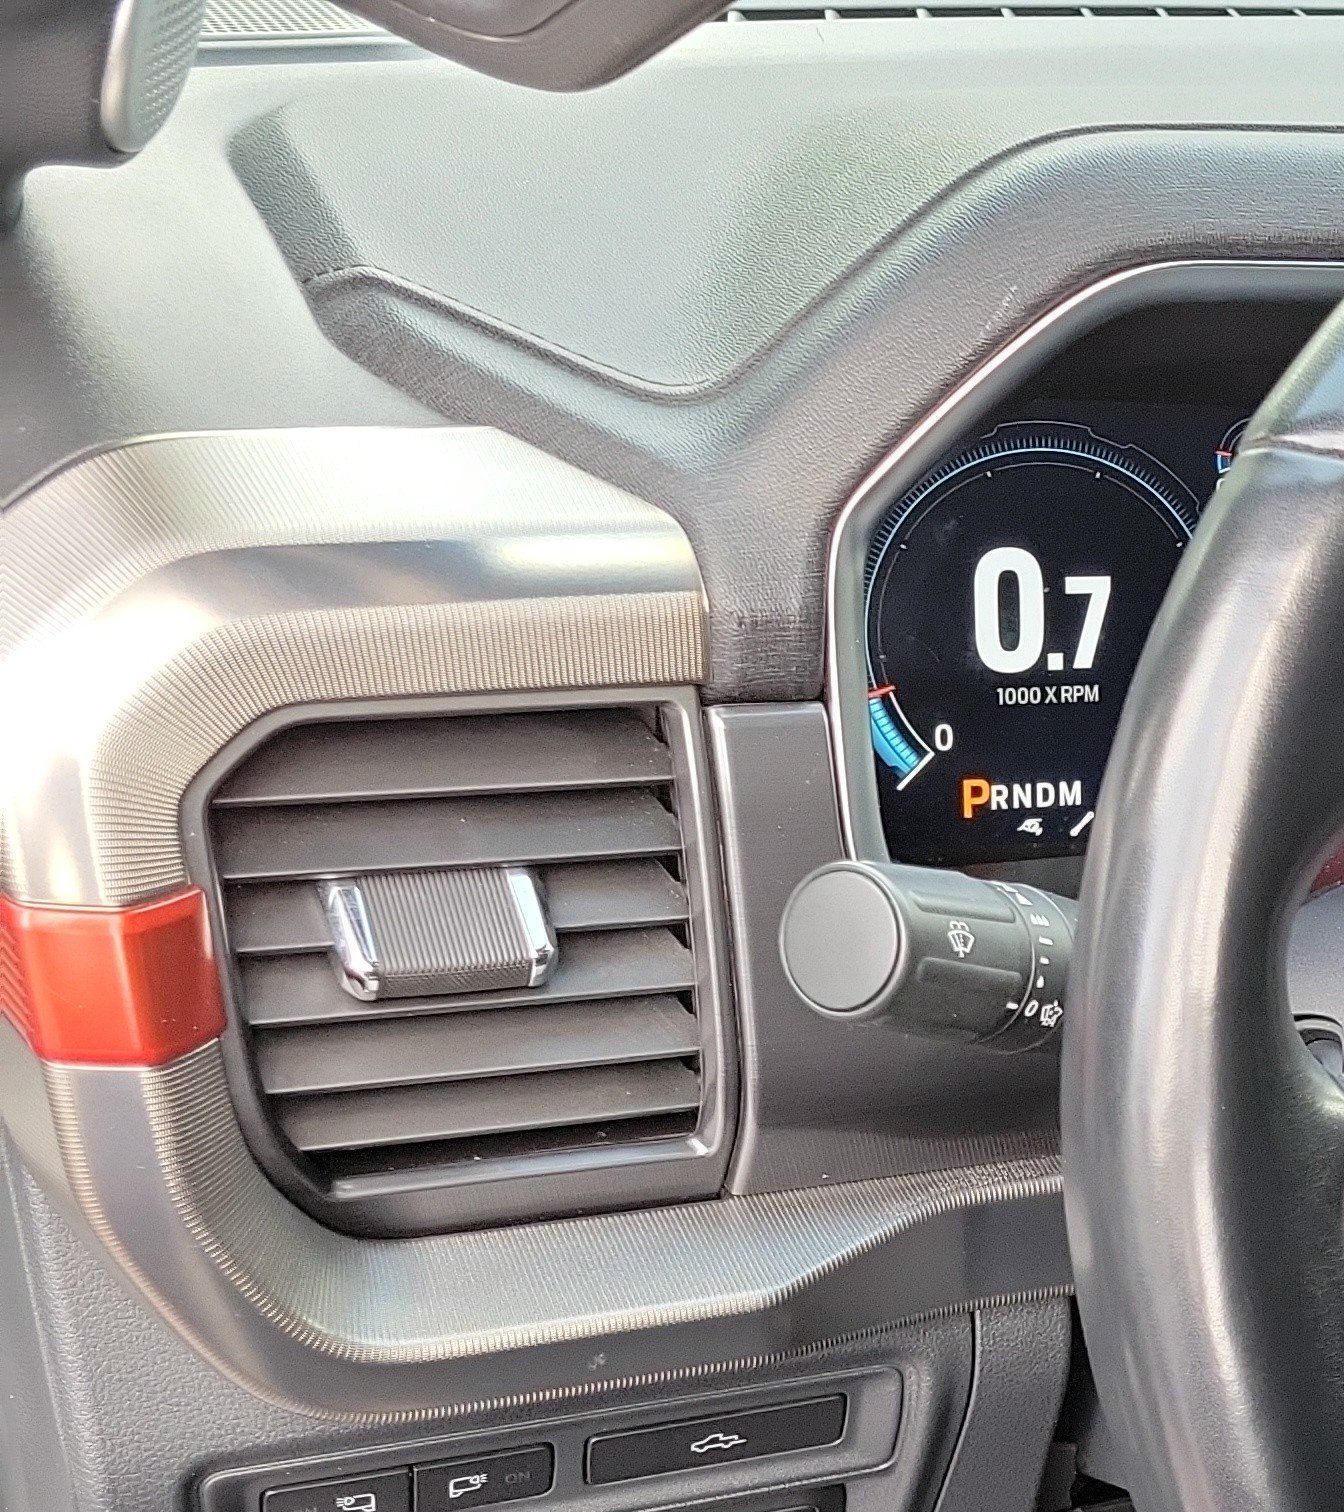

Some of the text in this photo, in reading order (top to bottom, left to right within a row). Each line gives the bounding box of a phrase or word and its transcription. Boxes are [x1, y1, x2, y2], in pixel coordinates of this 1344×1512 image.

[973, 546, 1112, 674] 0.7
[996, 684, 1100, 706] 1000 X RPM
[934, 723, 954, 752] 0
